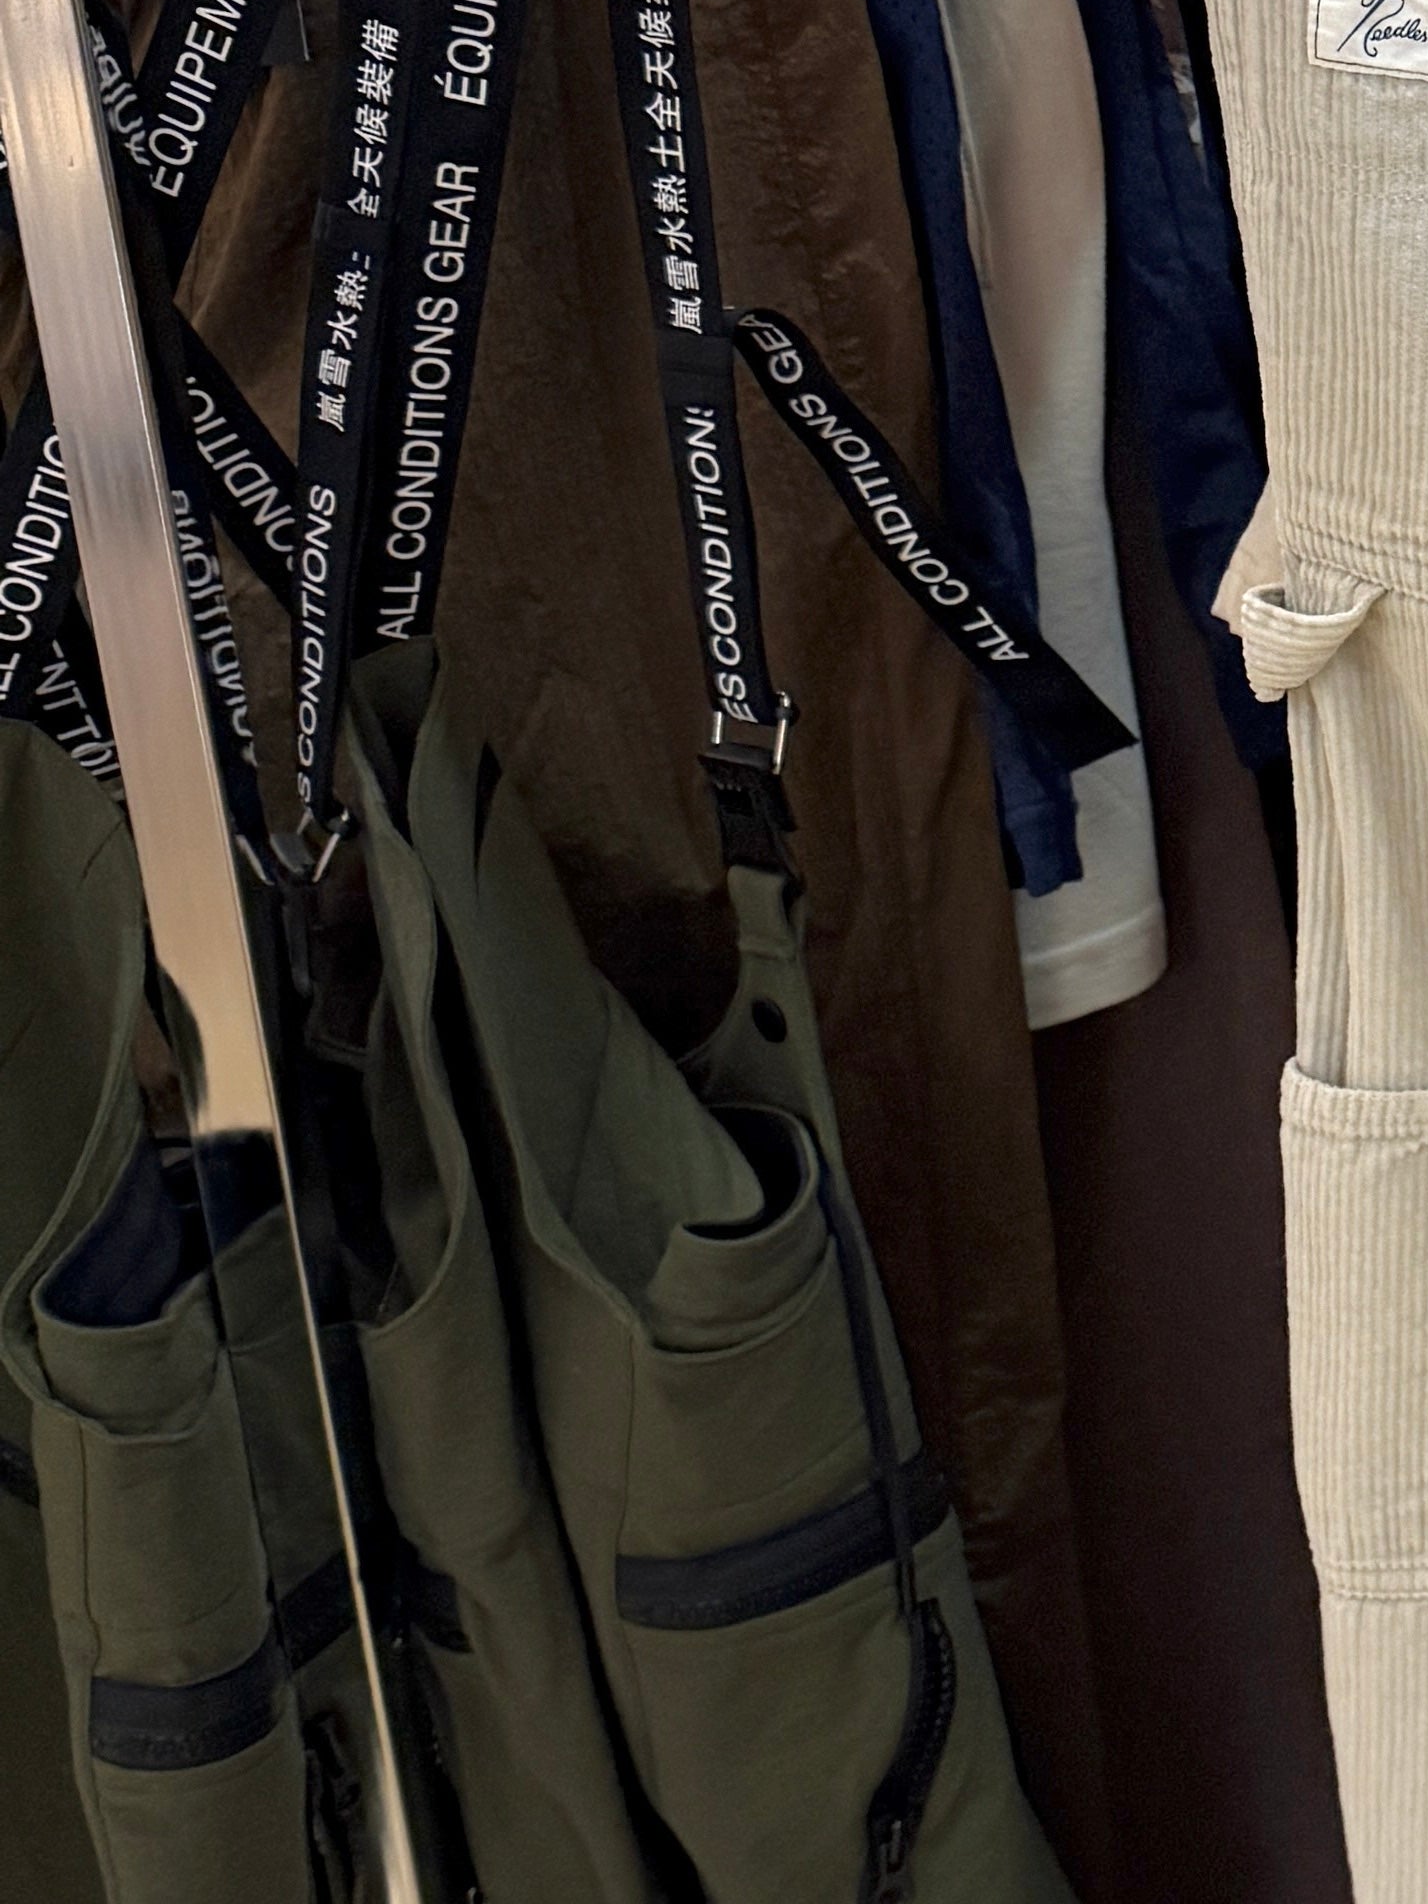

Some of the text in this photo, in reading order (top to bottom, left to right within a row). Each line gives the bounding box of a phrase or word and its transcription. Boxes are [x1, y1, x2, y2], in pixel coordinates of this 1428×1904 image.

[376, 161, 480, 640] ALL CONDITIONS GEAR
[788, 393, 969, 606] CONDITIONS
[300, 484, 337, 767] CONDITIONS
[684, 406, 743, 667] CONDITION
[960, 605, 1030, 662] ALL
